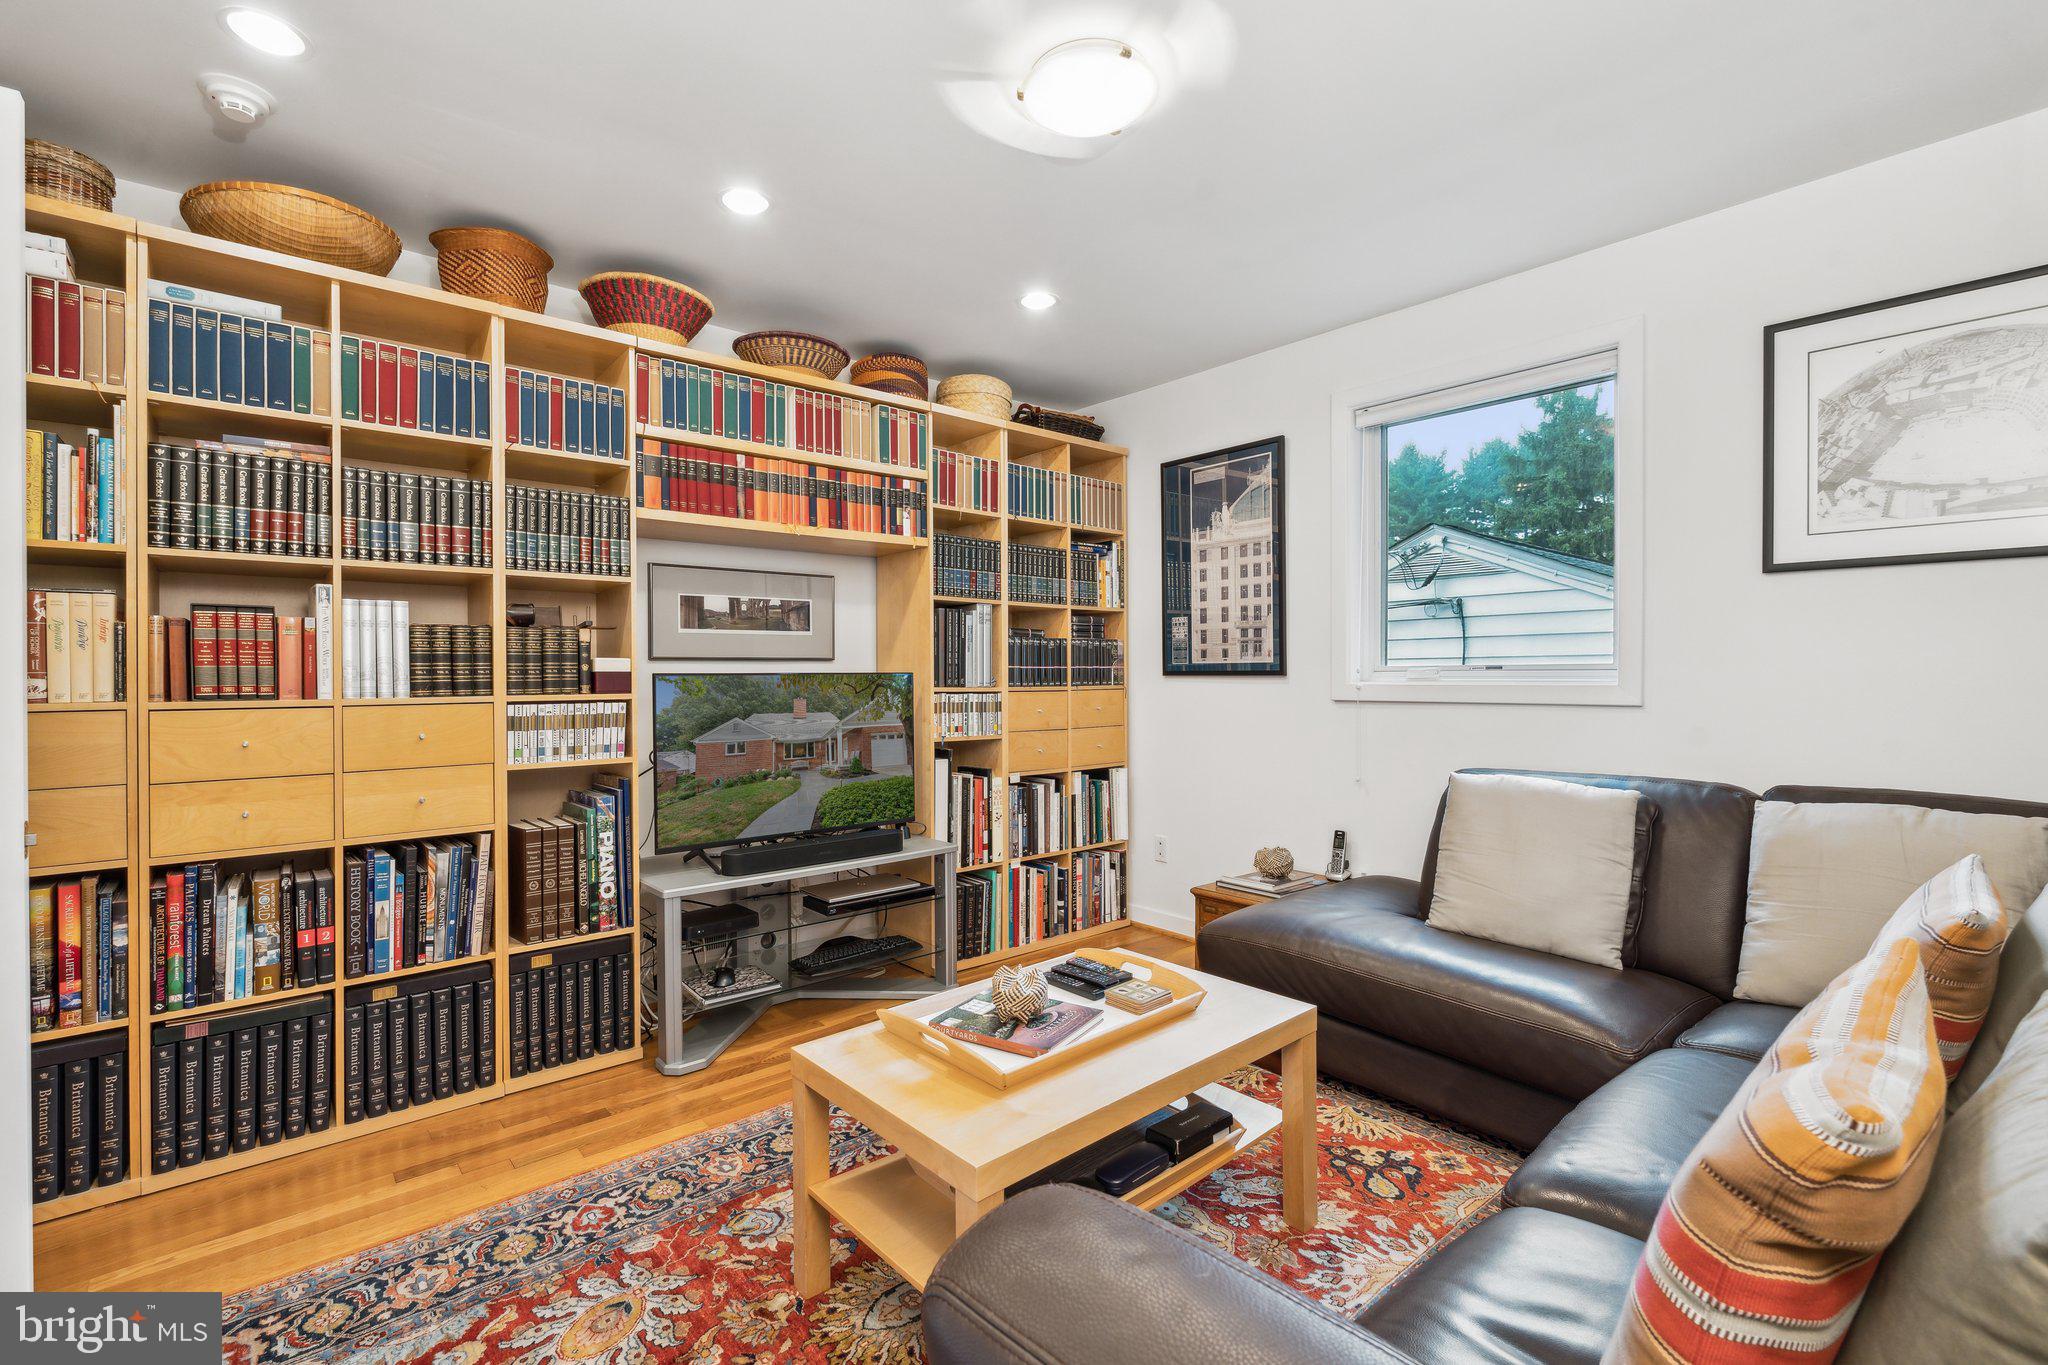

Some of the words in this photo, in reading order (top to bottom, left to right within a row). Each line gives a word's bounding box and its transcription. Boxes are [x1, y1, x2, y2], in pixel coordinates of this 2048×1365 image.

[156, 462, 164, 478] Great
[156, 479, 164, 497] Books
[180, 465, 188, 481] Great
[201, 466, 209, 482] Great
[180, 482, 188, 500] Books
[201, 483, 209, 501] Books
[479, 850, 488, 873] ITALY
[599, 831, 615, 898] PIANO
[185, 883, 194, 922] PALACES
[258, 883, 271, 921] WORLD
[350, 867, 361, 912] HISTORY
[477, 874, 487, 900] FROM
[102, 900, 110, 924] VILLAGES
[170, 903, 182, 949] rainforest
[203, 899, 212, 925] Dream
[299, 890, 307, 929] architecture
[438, 888, 446, 930] MONUMENTS
[474, 920, 483, 933] AIR
[476, 902, 485, 918] THE
[34, 915, 44, 950] JOURNEYS
[102, 933, 110, 958] ENGLAND
[156, 904, 164, 955] ARCHITECTURE
[202, 928, 212, 956] Palaces
[304, 934, 310, 943] 1
[322, 932, 330, 940] 2
[350, 915, 361, 945] BOOK
[36, 960, 45, 991] LIFETIME
[66, 958, 74, 990] LIFETIME
[156, 956, 164, 965] OF
[156, 967, 164, 1000] THAILAND
[566, 980, 574, 1023] Britannica
[622, 969, 630, 1011] Britannica
[461, 1003, 469, 1050] Britannica
[482, 999, 491, 1044] Britannica
[515, 990, 524, 1035] Britannica
[531, 986, 539, 1030] Britannica
[351, 1026, 361, 1076] Britannica
[373, 1022, 383, 1071] Britannica
[396, 1017, 405, 1065] Britannica
[418, 1012, 427, 1060] Britannica
[440, 1008, 448, 1055] Britannica
[931, 1024, 978, 1042] COURTYARDS
[241, 1049, 251, 1101] Britannica
[267, 1044, 277, 1096] Britannica
[293, 1038, 303, 1090] Britannica
[316, 1033, 327, 1084] Britannica
[159, 1066, 171, 1121] Britannica
[186, 1060, 198, 1115] Britannica
[213, 1054, 224, 1108] Britannica
[39, 1088, 51, 1146] Britannica
[72, 1081, 84, 1139] Britannica
[105, 1074, 117, 1132] Britannica
